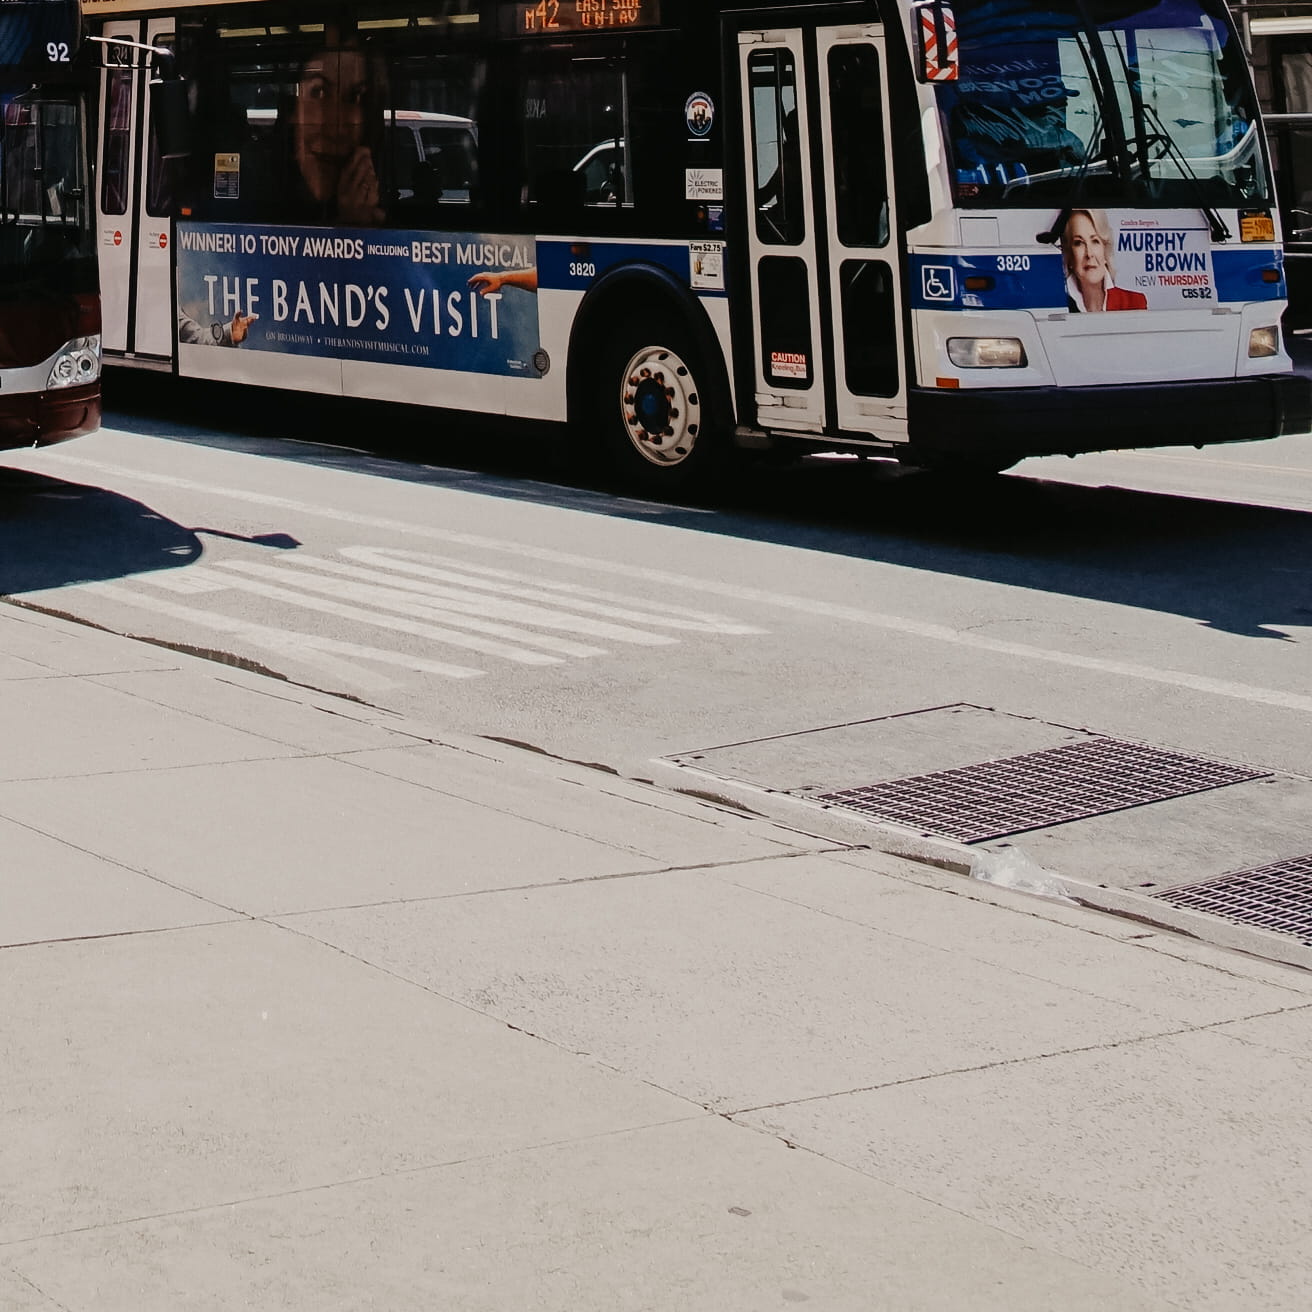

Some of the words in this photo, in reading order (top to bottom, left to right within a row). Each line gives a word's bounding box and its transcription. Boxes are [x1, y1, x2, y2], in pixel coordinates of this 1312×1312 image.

[45, 41, 71, 63] 92
[694, 179, 719, 188] ELECTRIC
[697, 187, 722, 195] POWERED
[179, 229, 237, 255] WINNER!
[240, 233, 257, 255] 10
[259, 235, 299, 258] TONY
[302, 237, 364, 260] AWARDS
[367, 243, 410, 258] INCLUDING
[411, 240, 452, 265] BEST
[455, 242, 533, 269] MUSICAL
[690, 242, 702, 252] Fare
[702, 242, 721, 253] $2.75
[1117, 232, 1187, 252] MURPHY
[569, 261, 596, 278] 3820
[996, 254, 1031, 274] 3820
[1145, 252, 1206, 272] BROWN
[1135, 276, 1157, 287] NEW
[1158, 274, 1209, 286] THURSDAYS
[203, 274, 261, 320] THE
[272, 280, 390, 331] BAND'S
[404, 287, 504, 340] VISIT
[771, 351, 806, 363] CAUTION
